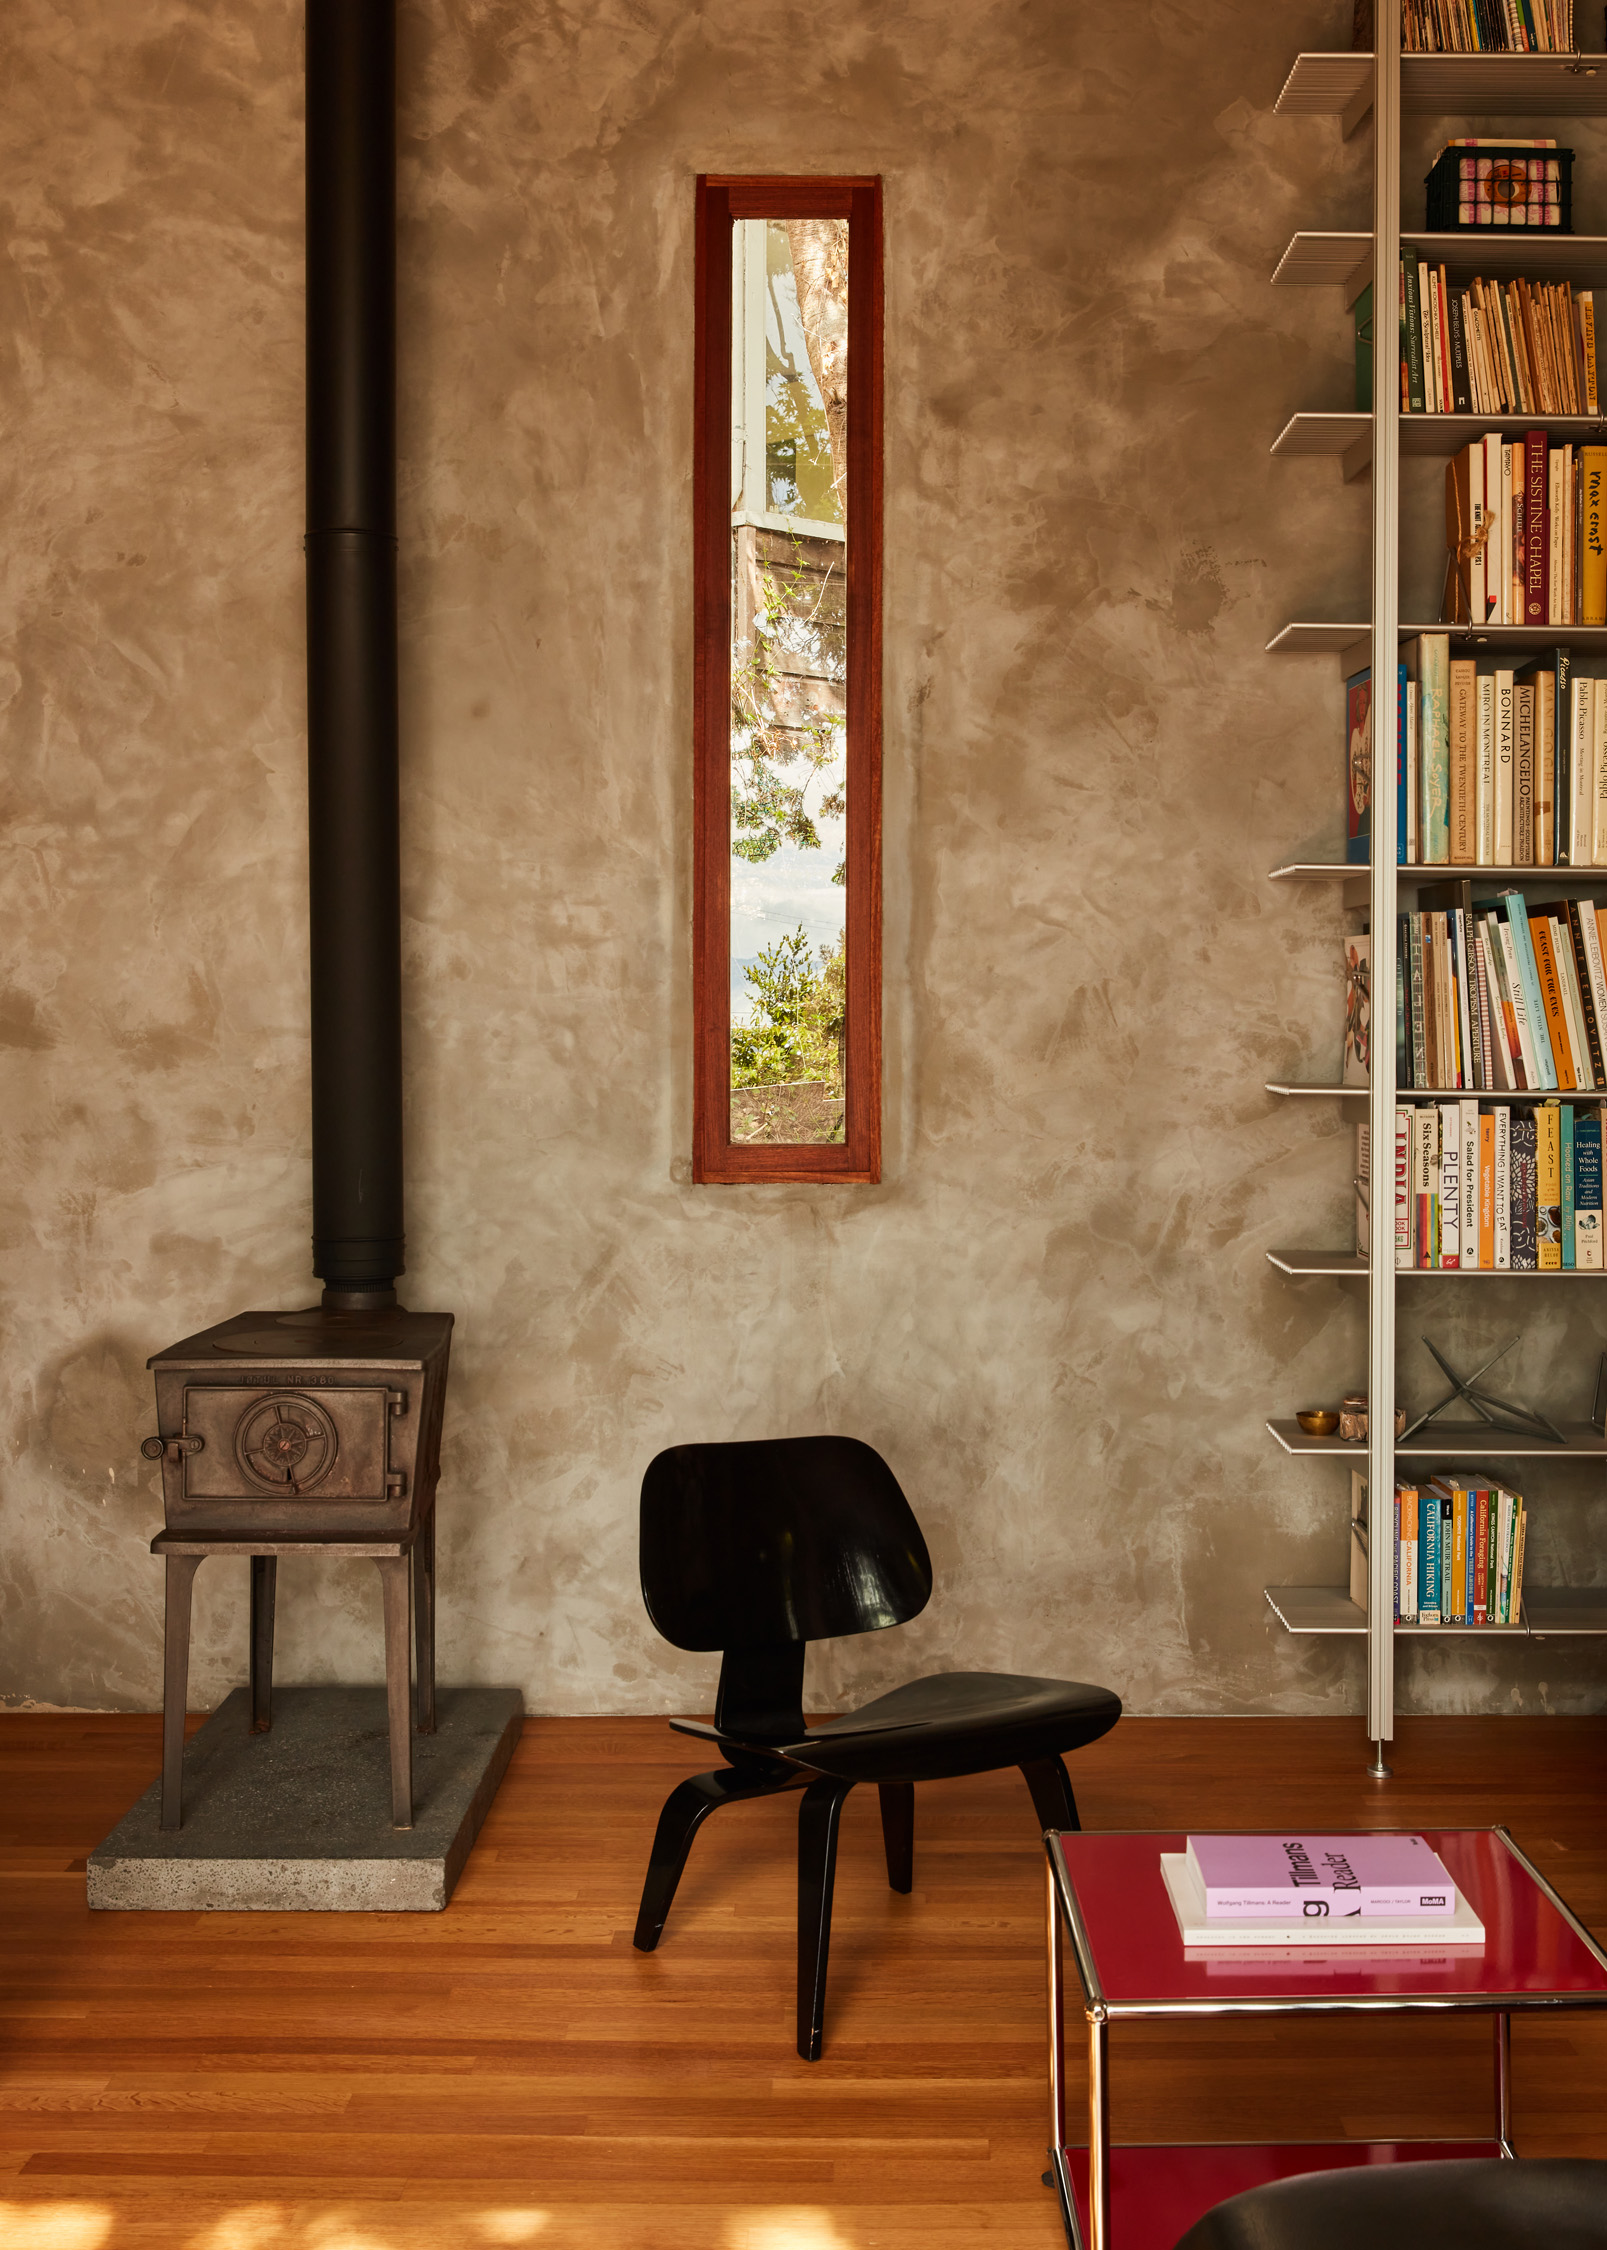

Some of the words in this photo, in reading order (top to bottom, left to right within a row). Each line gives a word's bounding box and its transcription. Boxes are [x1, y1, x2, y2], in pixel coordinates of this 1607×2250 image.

[1407, 272, 1415, 302] Anxious
[1408, 305, 1416, 333] Visions:
[1451, 299, 1459, 320] JOSEPH
[1423, 320, 1431, 349] Sculptural
[1585, 306, 1593, 348] IRVING
[1410, 335, 1418, 369] Surrealist
[1587, 353, 1596, 400] LAYTON
[1531, 441, 1543, 473] THE
[1530, 477, 1543, 533] SISTINE
[1589, 471, 1601, 508] max
[1589, 514, 1603, 556] ernst
[1529, 536, 1542, 594] CHAPEL
[1559, 657, 1570, 690] Picasso
[1579, 682, 1588, 705] Pablo
[1430, 689, 1443, 758] RAPHAEL
[1459, 731, 1466, 742] TO
[1501, 689, 1511, 763] BONNARD
[1579, 708, 1588, 740] Picasso
[1459, 745, 1467, 762] THE
[1519, 687, 1531, 796] MICHELANGELO
[1459, 764, 1467, 812] TWENTIETH
[1459, 814, 1467, 852] CENTURY
[1465, 913, 1473, 942] RALPH
[1503, 928, 1511, 945] Irving
[1586, 918, 1596, 941] ANNIE
[1467, 943, 1475, 975] GIBSON
[1538, 931, 1548, 957] FEAST
[1543, 959, 1552, 975] FOR
[1589, 943, 1601, 980] LEIBOVITZ
[1469, 978, 1477, 1015] TROPISM
[1512, 982, 1524, 1004] Still
[1546, 977, 1555, 995] THE
[1570, 906, 1585, 962] ANNIE
[1580, 973, 1601, 1068] LEIBOVITZ
[1595, 983, 1606, 1012] WOMEN
[1514, 1006, 1527, 1026] Life
[1550, 997, 1559, 1017] EYES
[1471, 1020, 1481, 1063] APERTURE
[1423, 1123, 1432, 1139] Six
[1498, 1113, 1506, 1167] EVERYTHING
[1576, 1142, 1600, 1150] Healing
[1423, 1143, 1432, 1187] Seasons
[1466, 1141, 1474, 1166] Salad
[1564, 1143, 1572, 1171] Hooked
[1444, 1152, 1458, 1229] PLENTY
[1565, 1174, 1571, 1183] on
[1466, 1185, 1474, 1227] President
[1496, 1203, 1503, 1214] TO
[1497, 1217, 1507, 1231] EAT
[1426, 1503, 1435, 1560] CALIFORNIA
[1477, 1538, 1486, 1568] Foraging
[1426, 1563, 1435, 1597] HIKING
[1283, 1843, 1321, 1887] Tillmans
[1321, 1853, 1361, 1893] Reader
